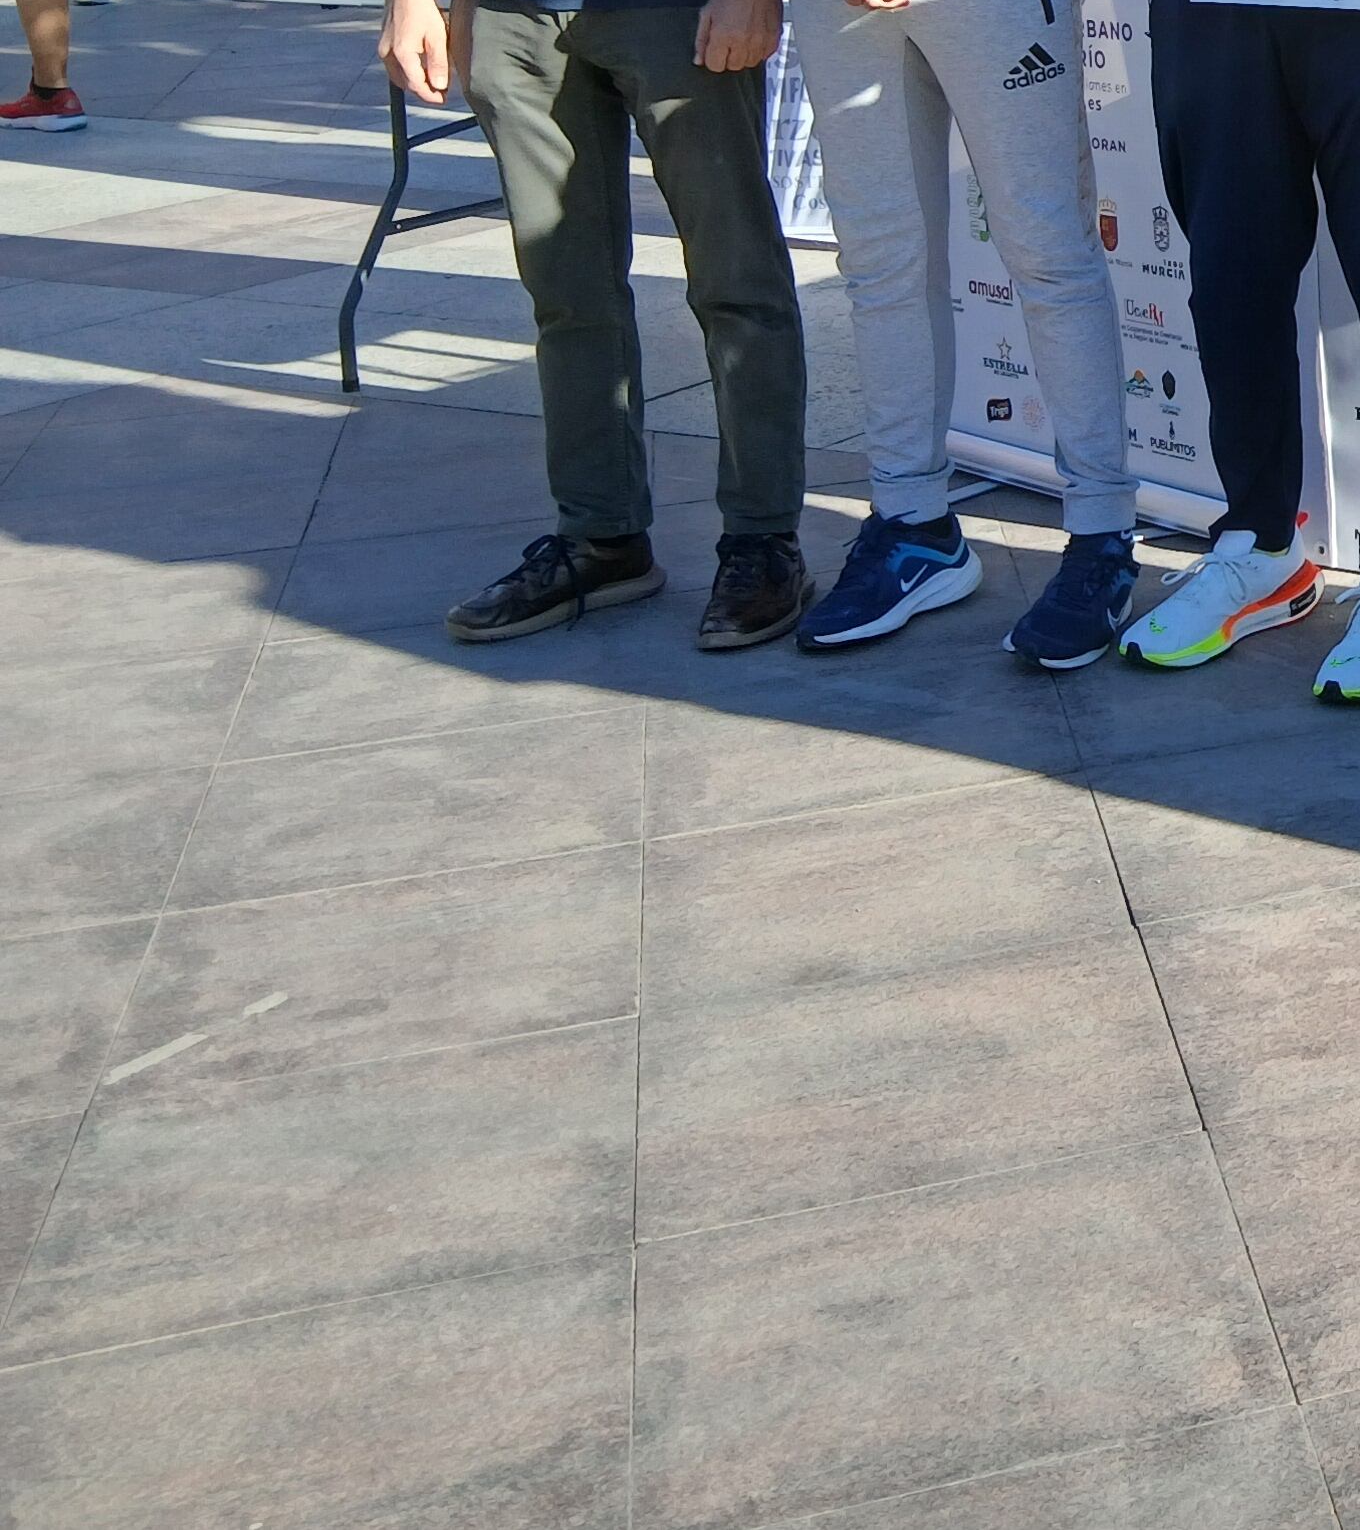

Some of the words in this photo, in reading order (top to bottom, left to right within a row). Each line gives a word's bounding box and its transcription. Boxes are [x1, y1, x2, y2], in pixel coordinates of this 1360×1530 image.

[1003, 63, 1066, 90] adidas
[1142, 263, 1186, 281] MURCIA
[968, 279, 1014, 302] amusal
